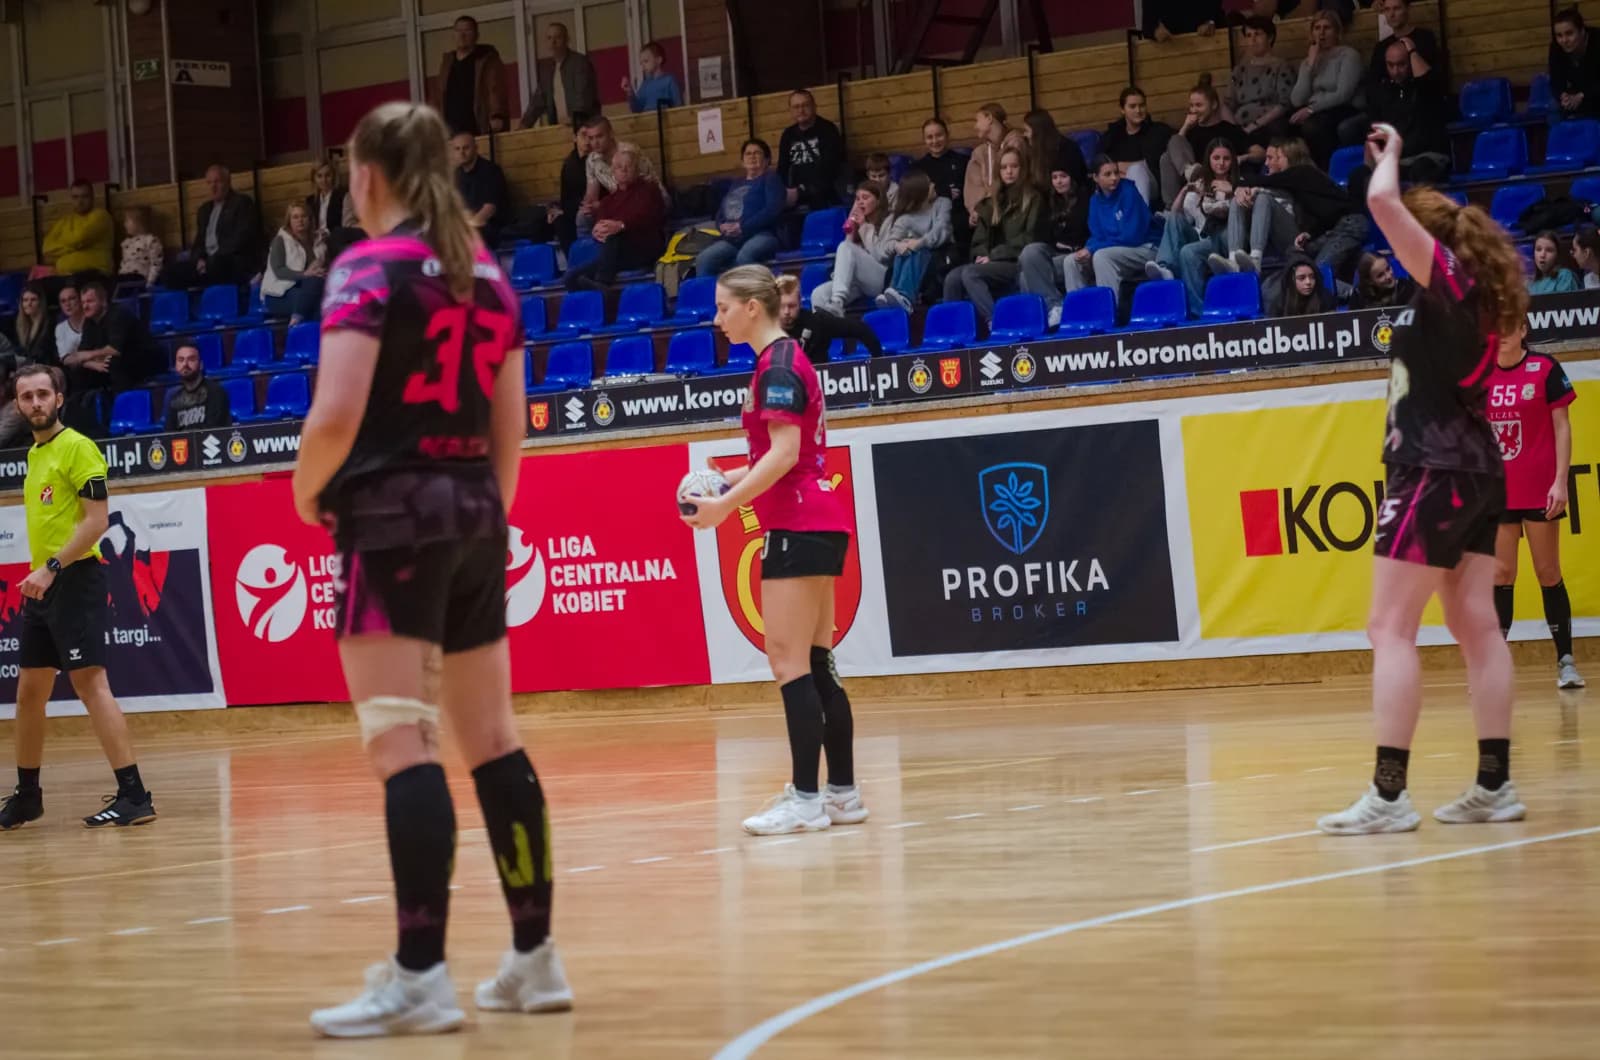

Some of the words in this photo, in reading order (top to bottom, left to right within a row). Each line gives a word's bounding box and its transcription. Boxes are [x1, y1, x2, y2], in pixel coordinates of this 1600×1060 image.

[175, 69, 193, 82] A
[706, 129, 716, 144] A
[1527, 307, 1600, 329] www
[1045, 318, 1361, 373] www.koronahandball.pl
[622, 384, 749, 416] www.koron
[1491, 384, 1517, 407] 55
[253, 435, 302, 454] www
[547, 535, 597, 559] LIGA
[550, 557, 678, 588] CENTRALNA
[942, 552, 1110, 601] PROFIKA
[552, 589, 628, 615] KOBIET
[971, 600, 1088, 623] BROKER
